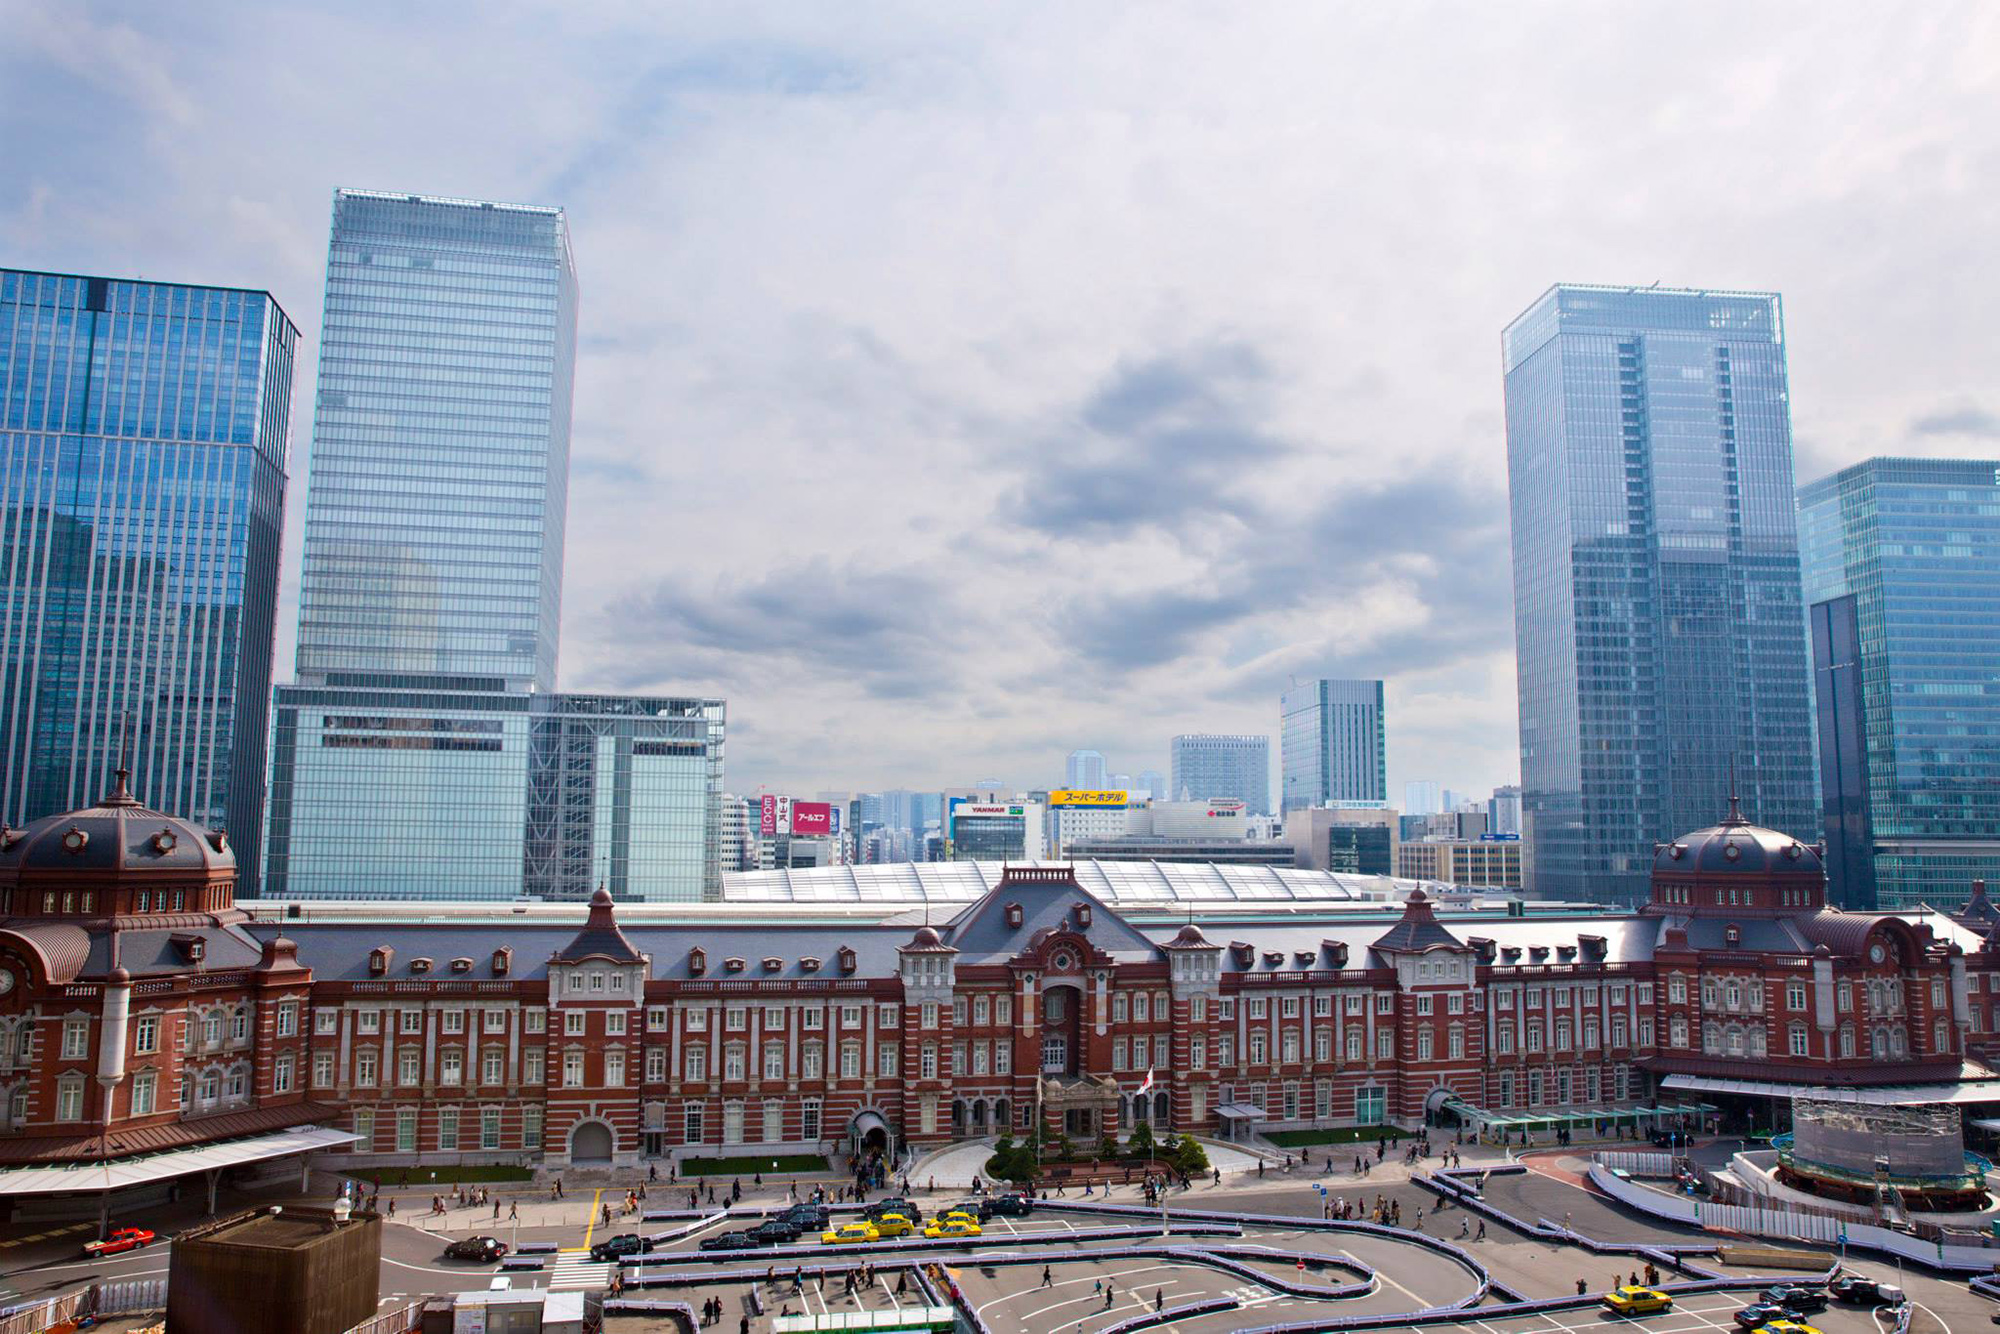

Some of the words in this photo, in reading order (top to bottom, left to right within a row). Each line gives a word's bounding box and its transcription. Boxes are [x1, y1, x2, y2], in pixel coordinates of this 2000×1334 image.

[1064, 792, 1124, 801] スーパーホテル
[798, 813, 825, 821] アールエフ
